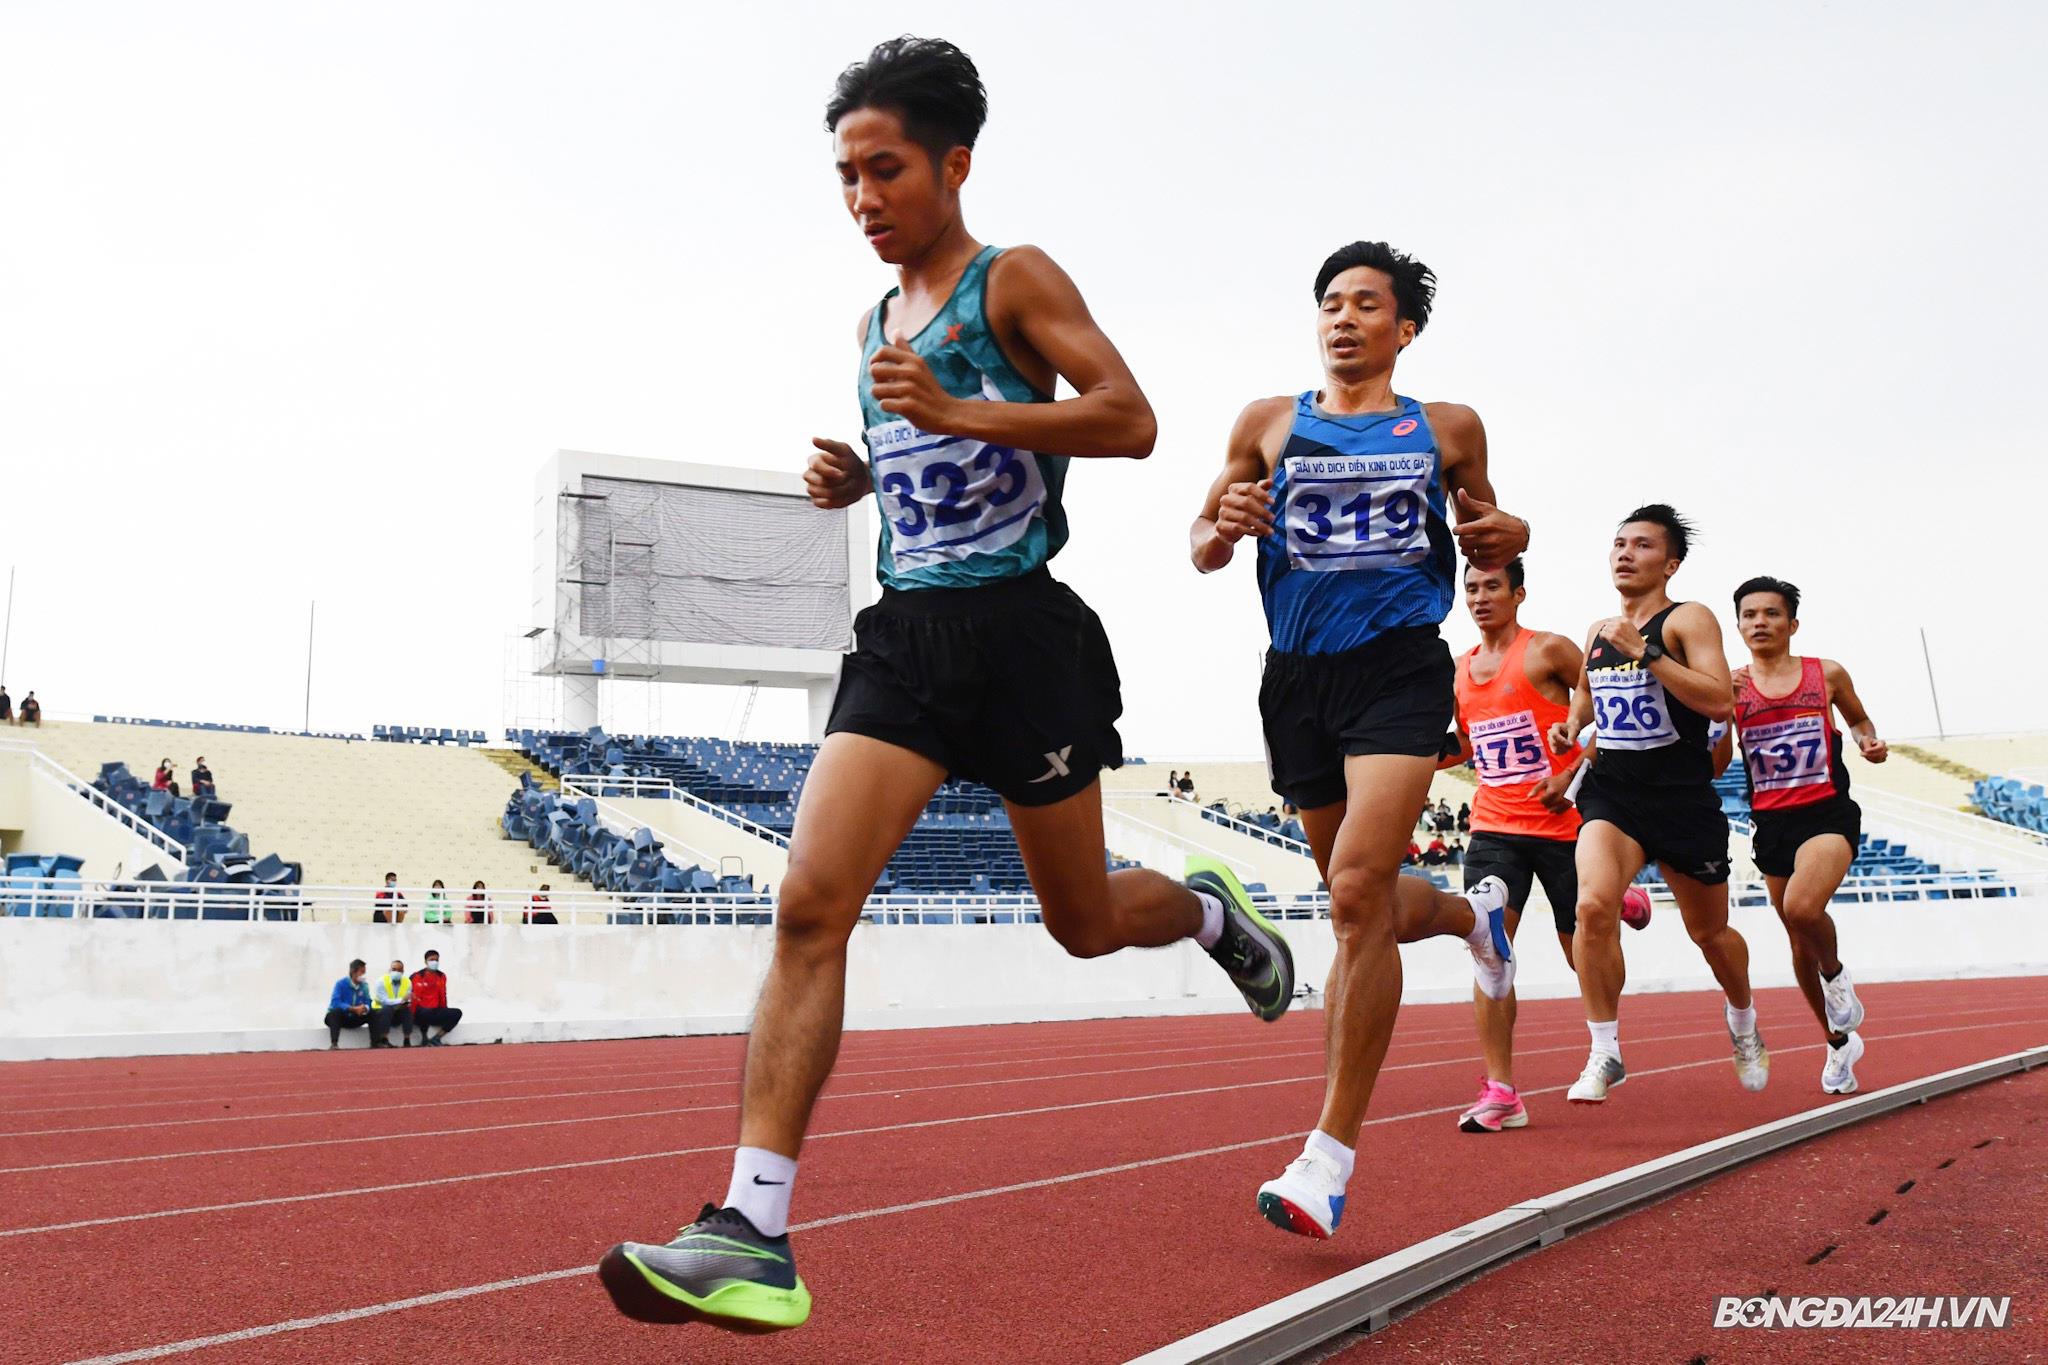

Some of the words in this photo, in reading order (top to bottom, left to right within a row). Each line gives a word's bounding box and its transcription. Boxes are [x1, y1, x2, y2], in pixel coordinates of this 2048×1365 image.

[1368, 460, 1387, 472] KINH
[1389, 456, 1411, 471] QUỐC
[1413, 459, 1425, 470] GIA
[882, 443, 1027, 537] 323
[1293, 490, 1420, 544] 319
[1593, 695, 1661, 730] 326
[1476, 734, 1541, 770] 175
[1749, 738, 1821, 775] 137
